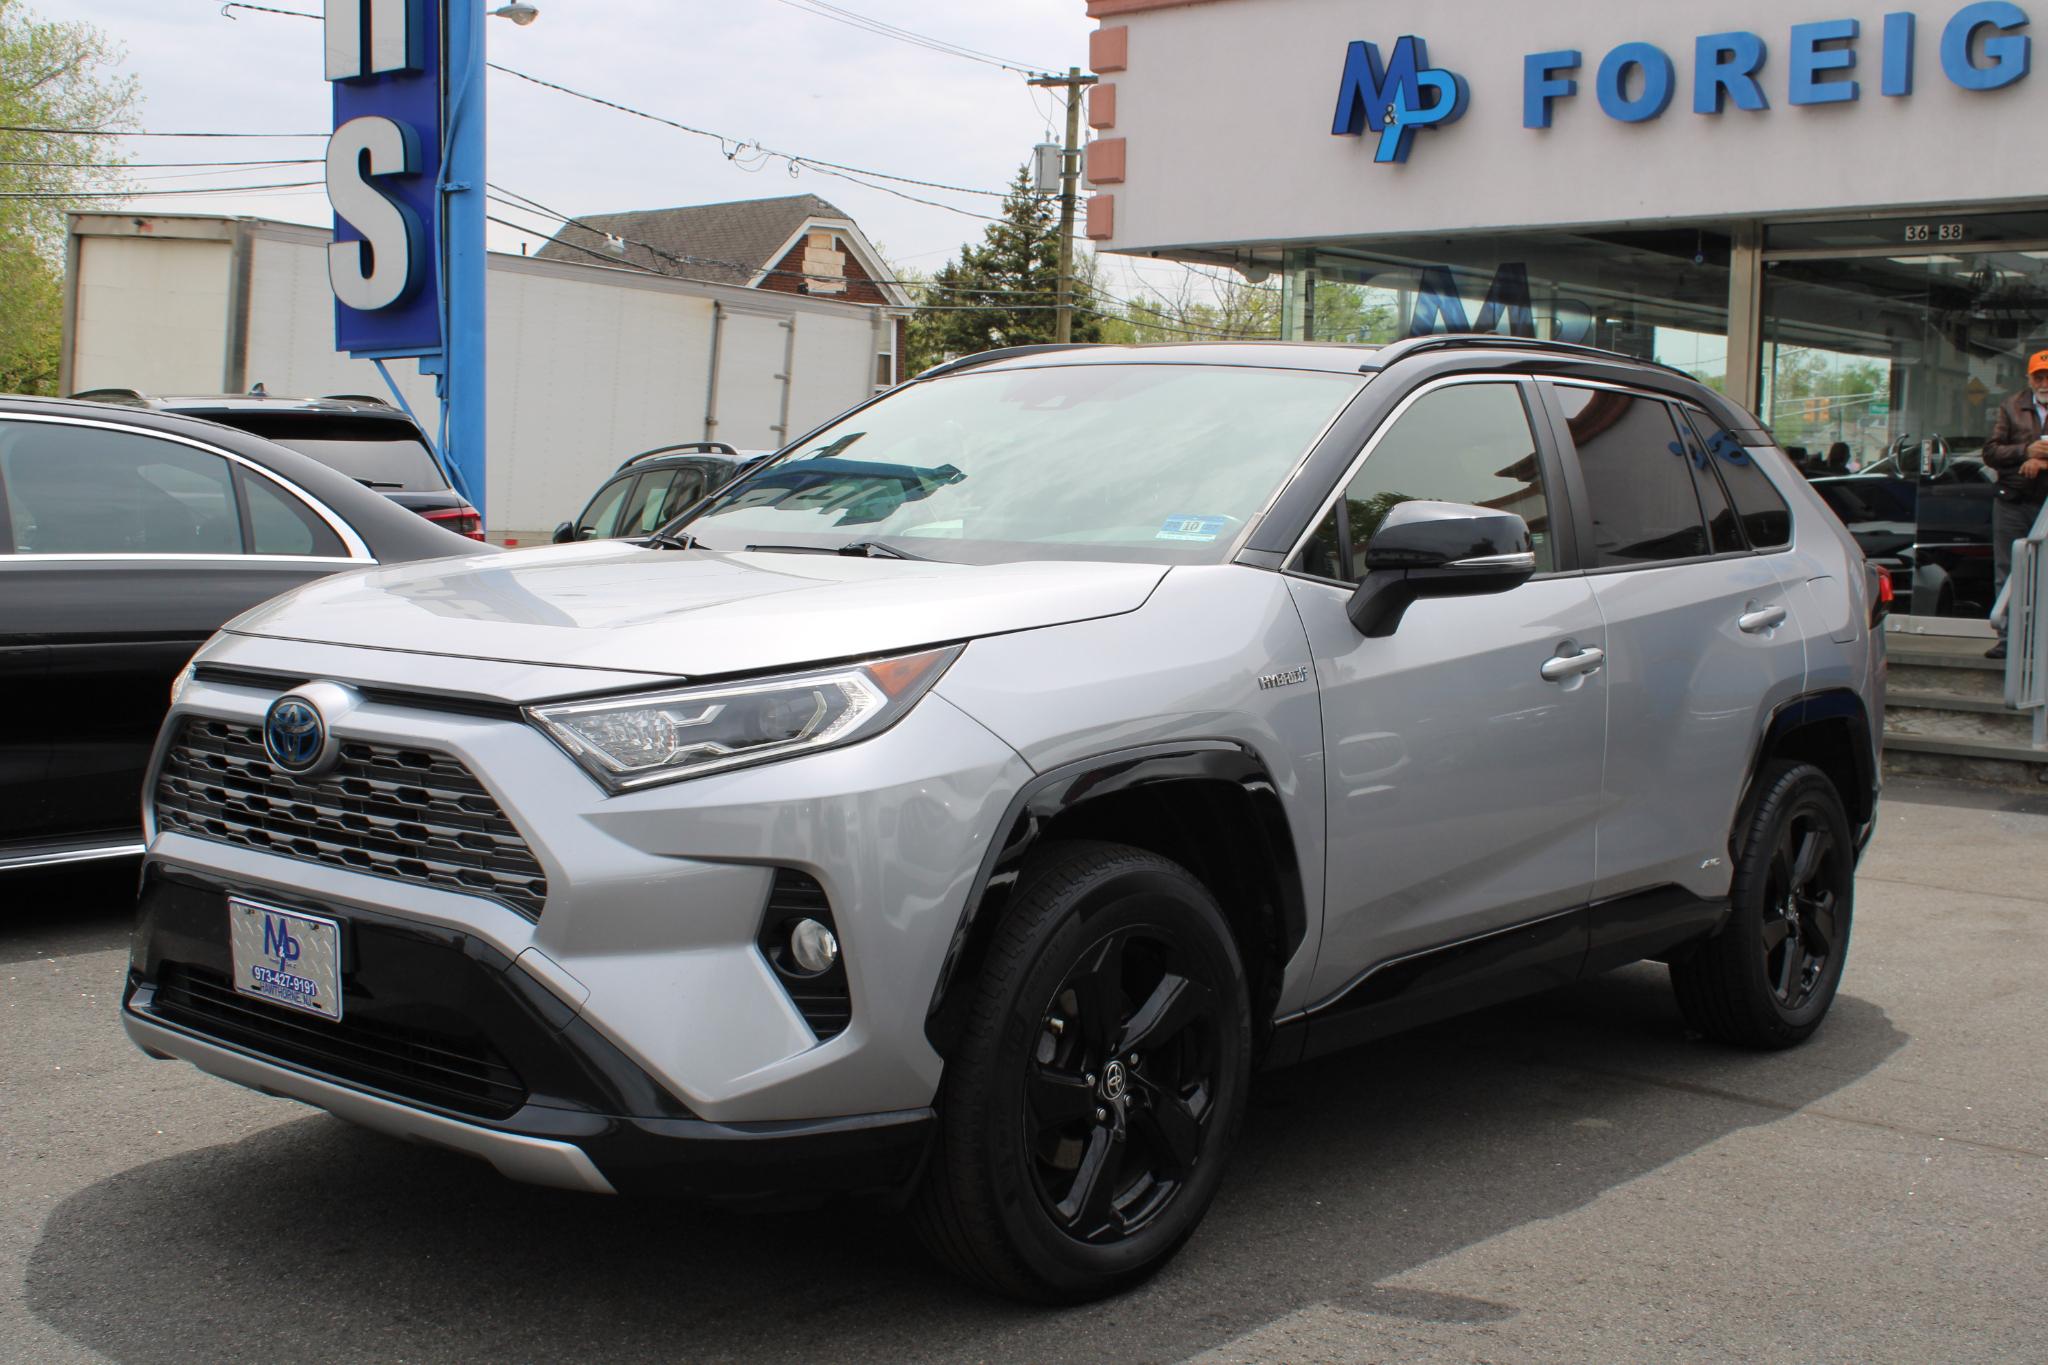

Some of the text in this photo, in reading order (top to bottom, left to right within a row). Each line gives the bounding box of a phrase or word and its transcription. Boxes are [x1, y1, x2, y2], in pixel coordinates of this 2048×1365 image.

[1523, 0, 2031, 129] FOREIG
[1258, 666, 1308, 690] HYBRID
[254, 966, 316, 996] 973-427-9191
